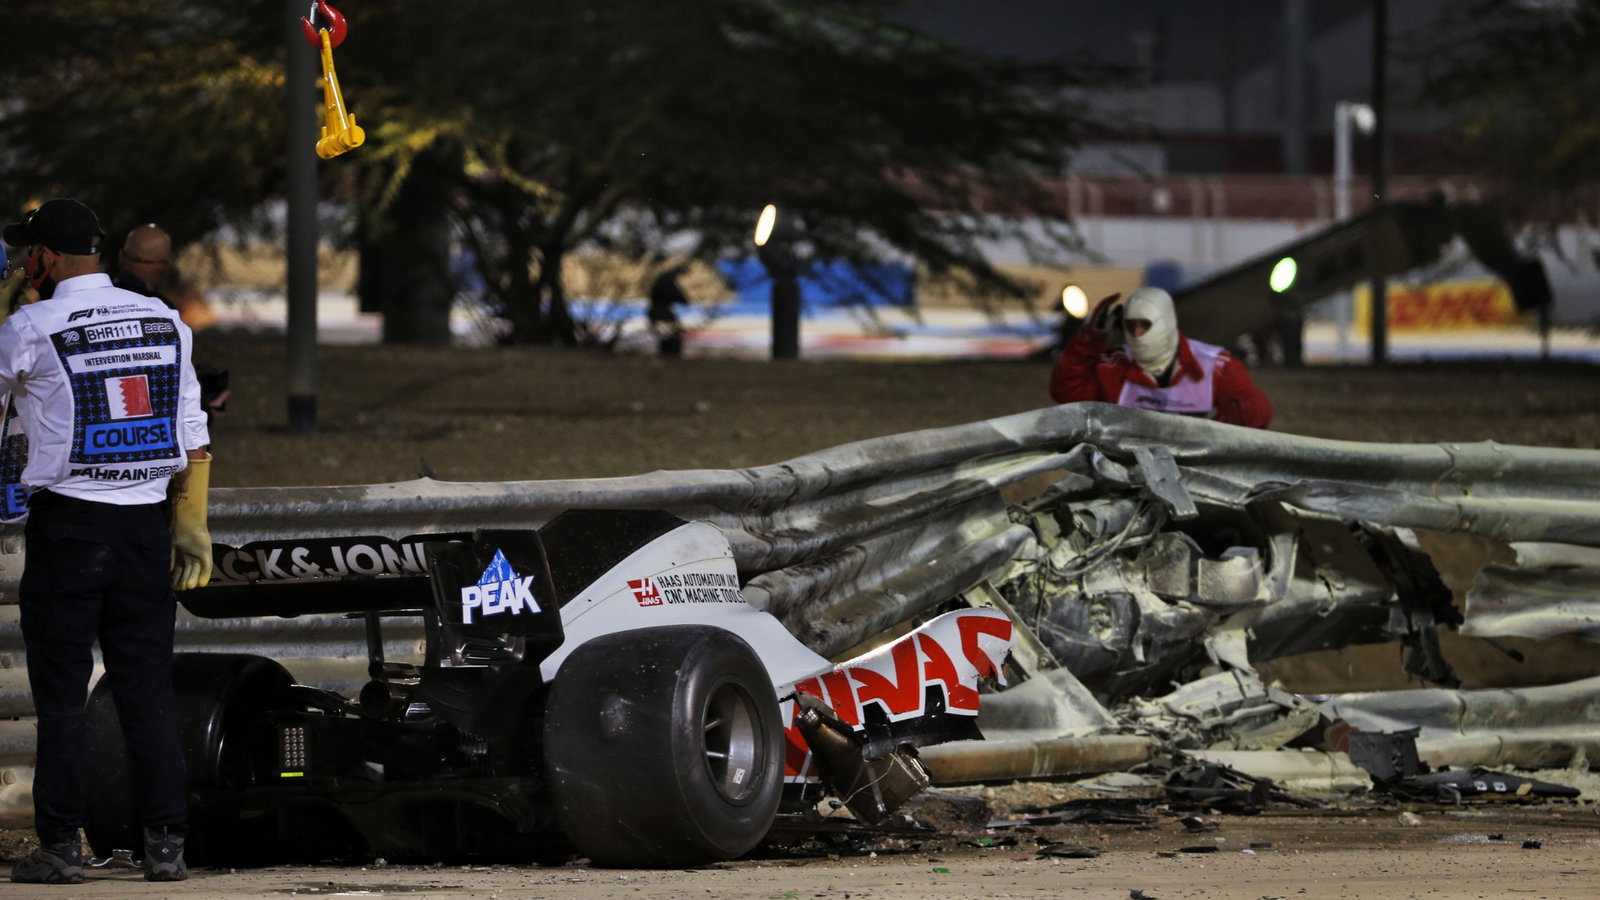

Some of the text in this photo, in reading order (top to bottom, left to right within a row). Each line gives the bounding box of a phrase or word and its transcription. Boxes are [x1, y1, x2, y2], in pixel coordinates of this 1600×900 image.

[87, 324, 140, 341] BHR1111
[144, 323, 175, 334] 2020
[84, 351, 162, 367] INTERVENTION MARSHAL
[92, 423, 169, 449] COURSE
[656, 574, 682, 589] HAAS
[682, 573, 725, 588] AUTOMATION
[461, 575, 542, 625] PEAK
[664, 588, 746, 604] CNC MACHINE TOOLS
